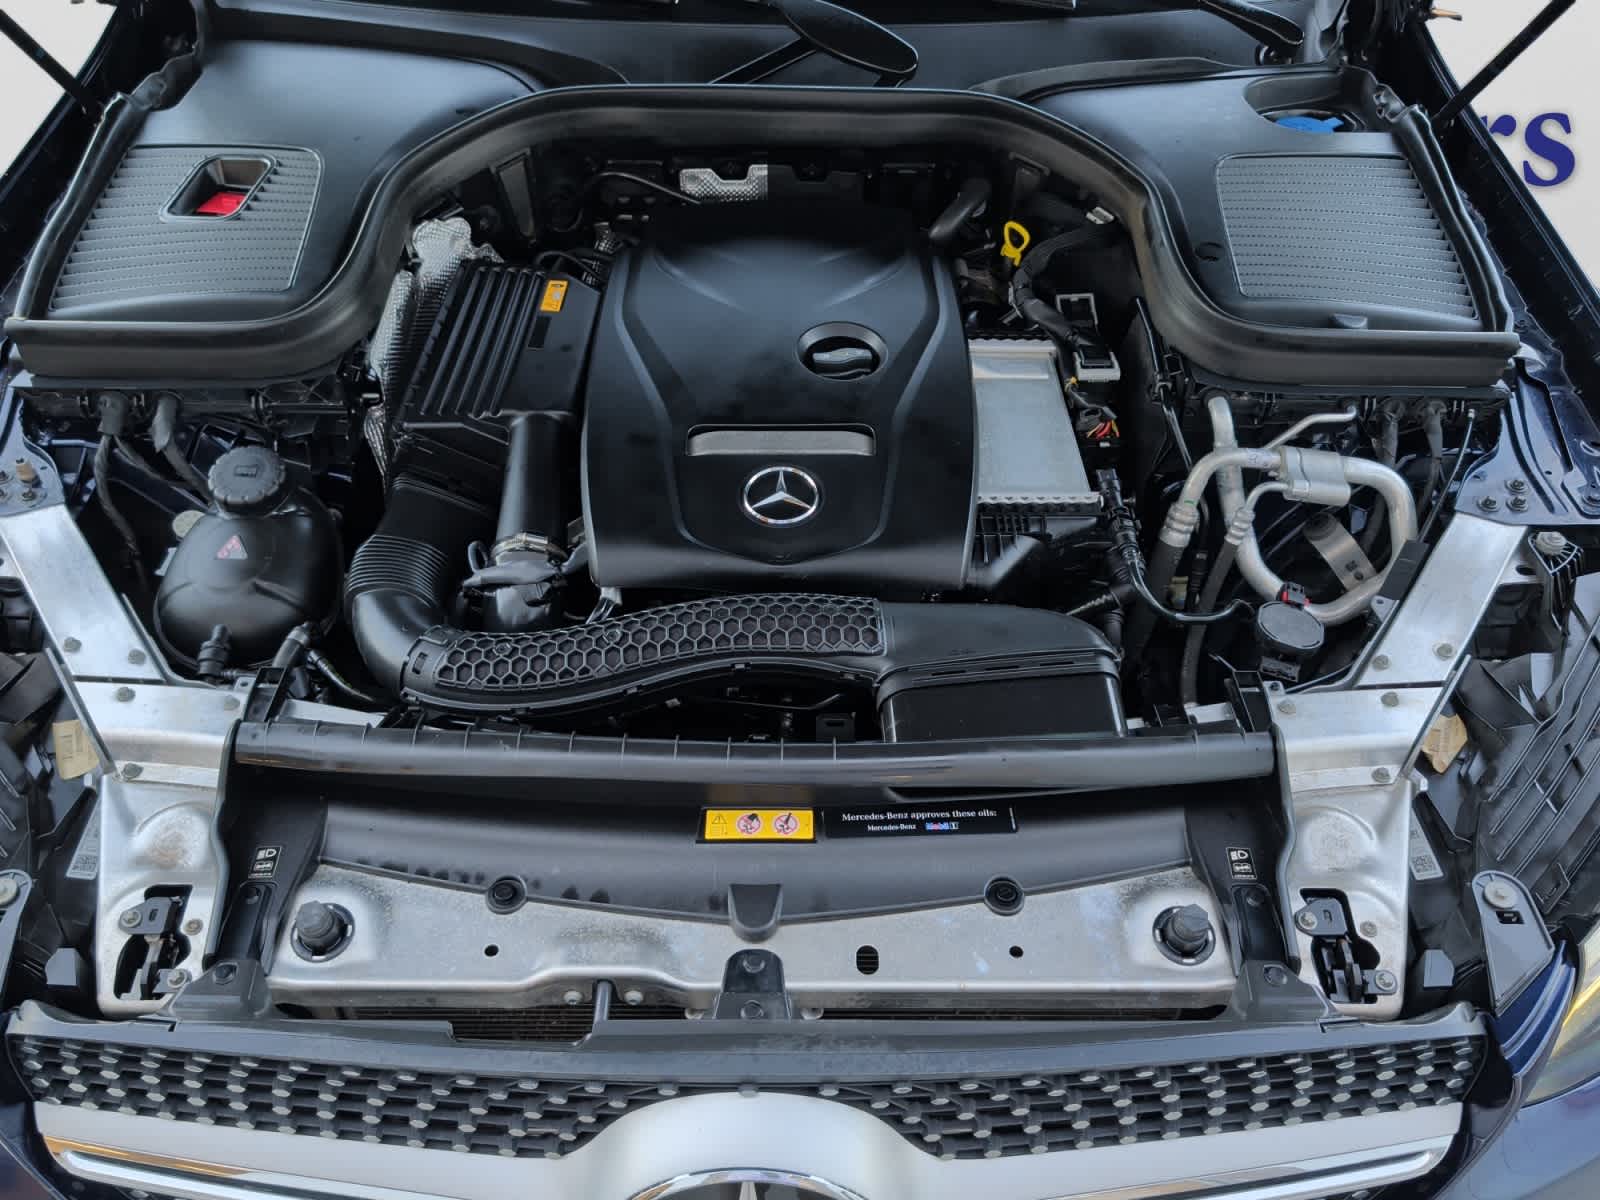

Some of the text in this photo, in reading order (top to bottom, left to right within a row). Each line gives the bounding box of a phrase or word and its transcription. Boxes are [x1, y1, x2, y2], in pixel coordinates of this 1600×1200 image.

[842, 812, 908, 821] Mercedes-Benz
[911, 811, 950, 820] approves
[952, 809, 976, 817] these
